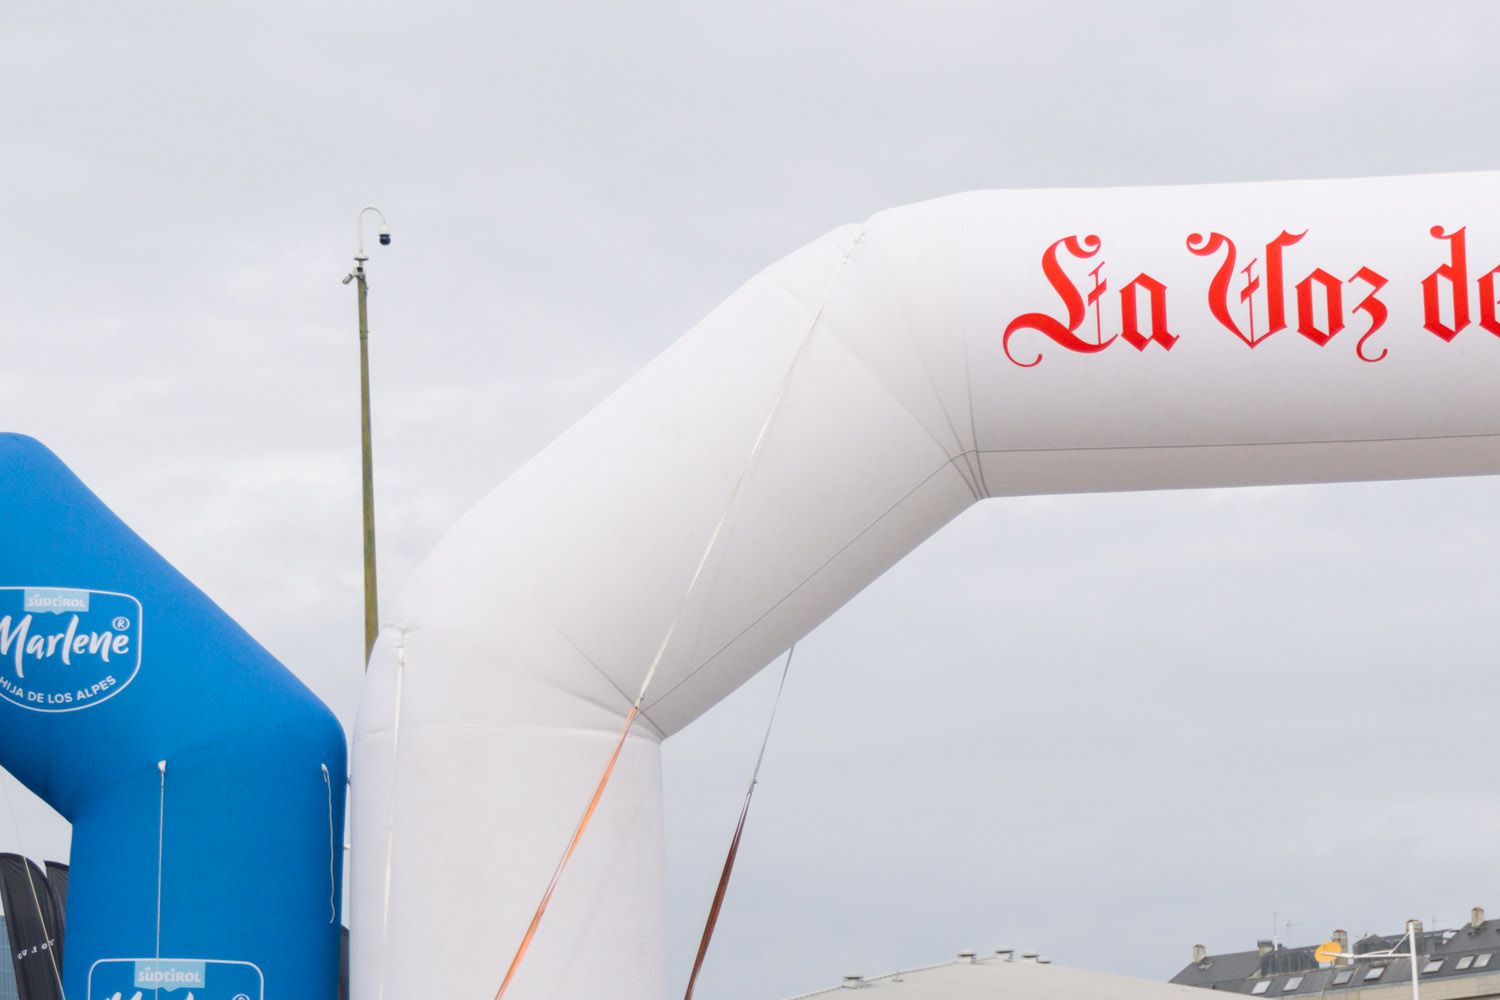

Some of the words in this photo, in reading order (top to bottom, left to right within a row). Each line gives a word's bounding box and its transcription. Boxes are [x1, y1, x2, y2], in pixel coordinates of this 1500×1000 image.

[1002, 233, 1182, 368] La
[1186, 228, 1389, 364] Voz
[0, 614, 130, 679] Marlene
[0, 676, 24, 698] HIJA
[27, 691, 44, 703] DE
[48, 692, 73, 704] LOS
[76, 675, 117, 701] ALPES
